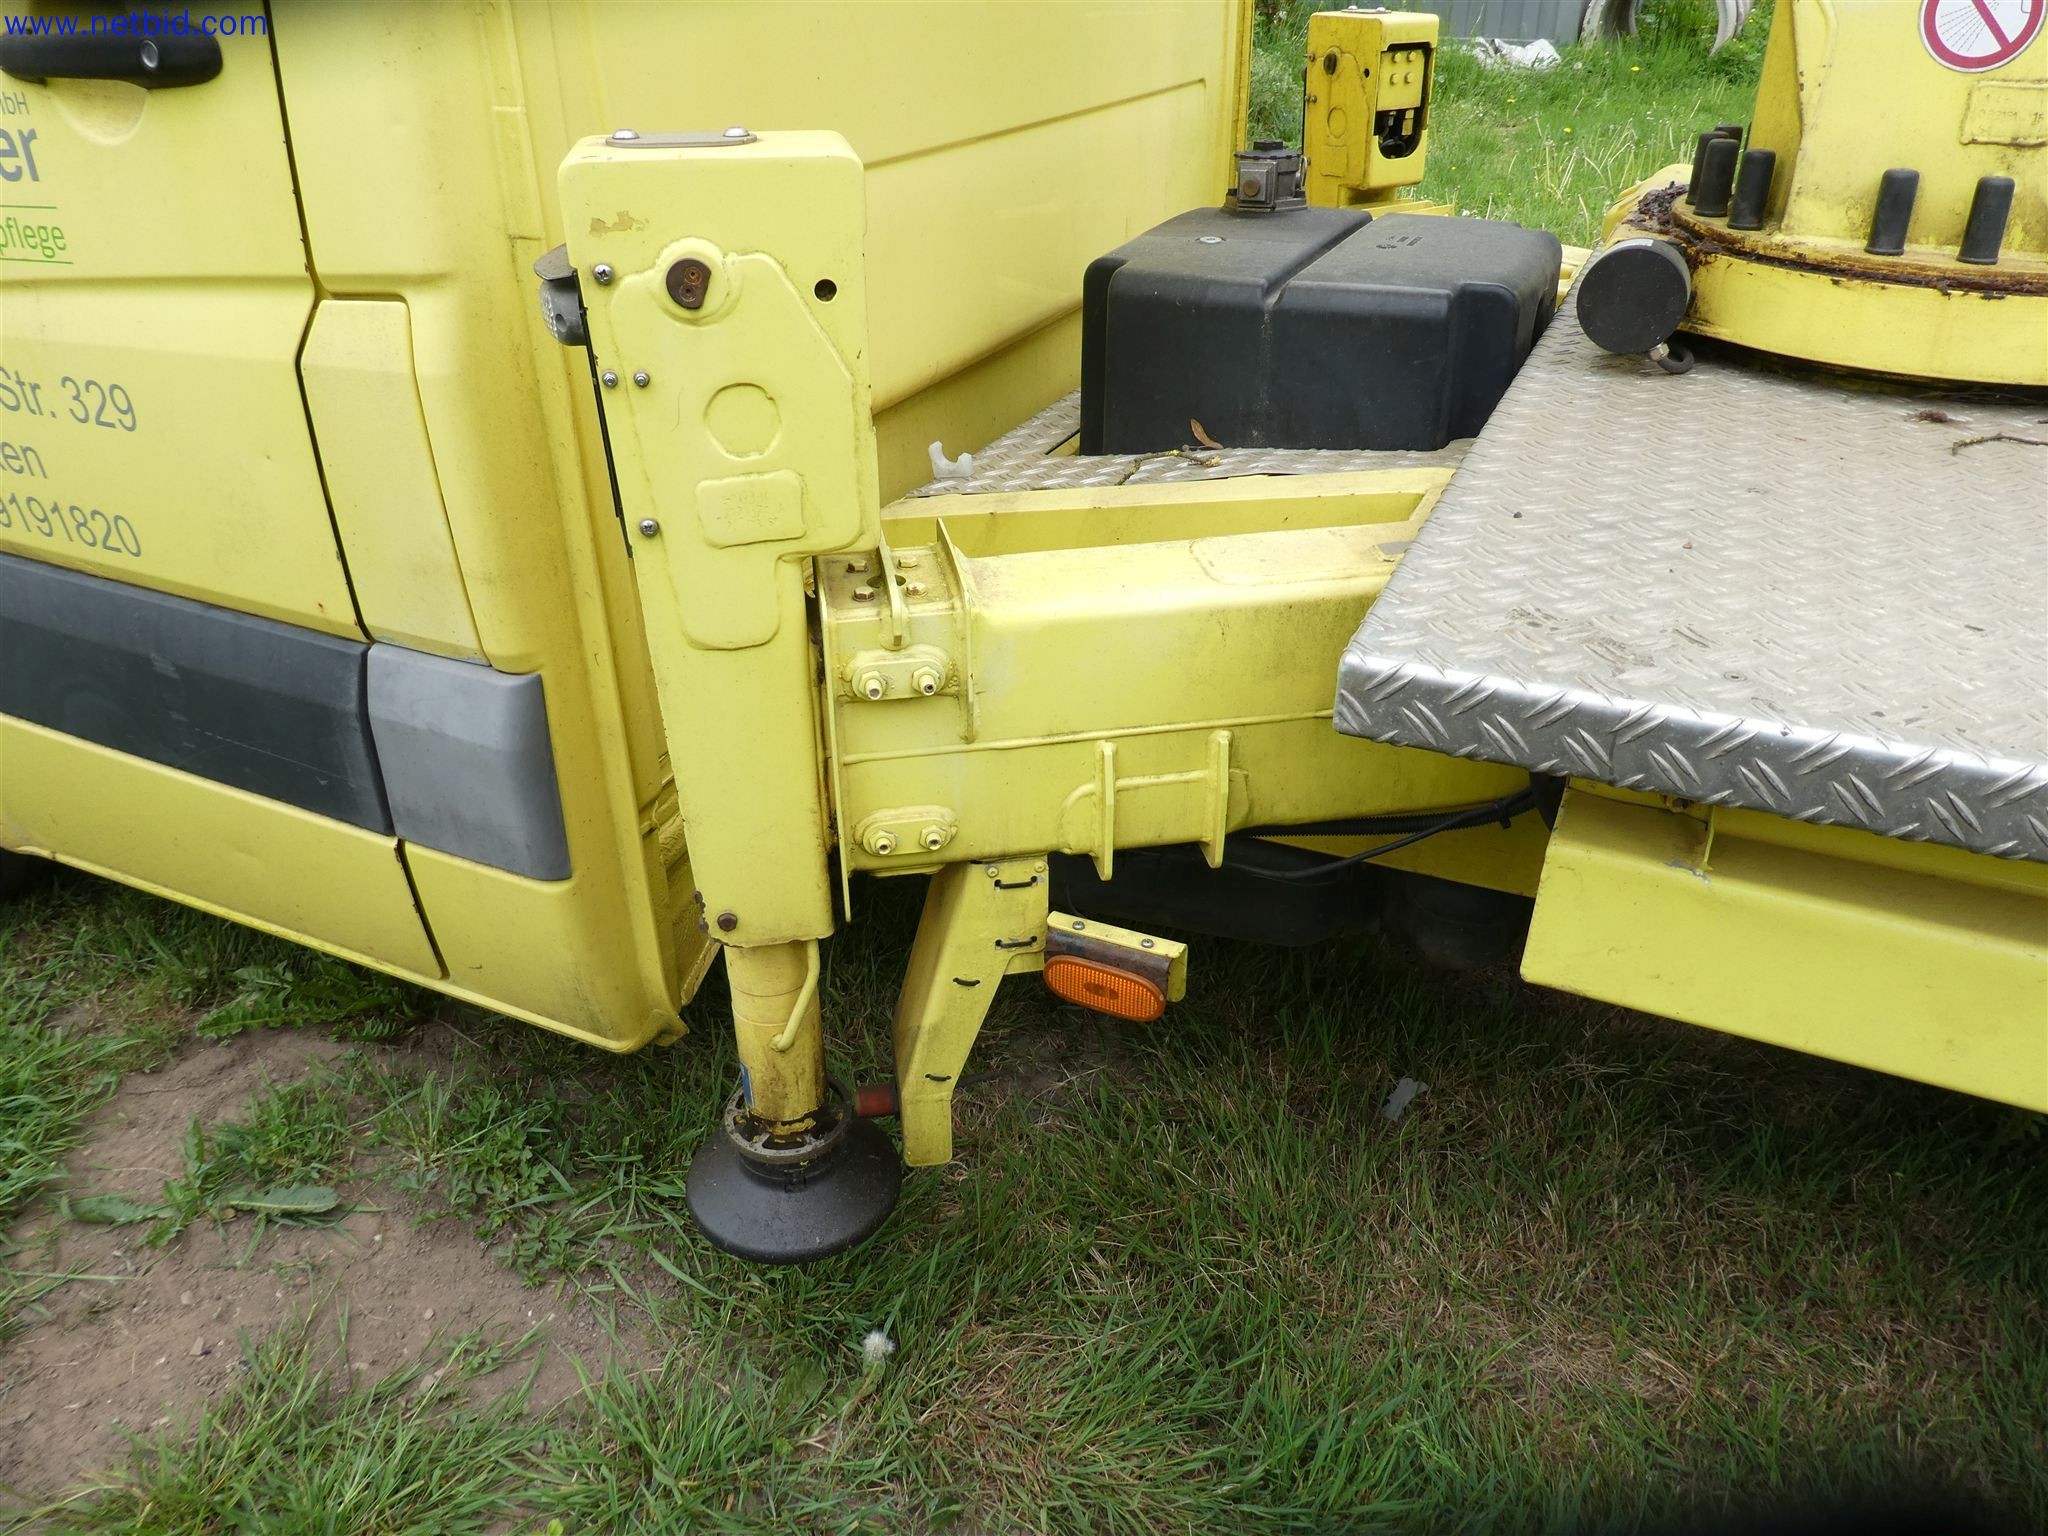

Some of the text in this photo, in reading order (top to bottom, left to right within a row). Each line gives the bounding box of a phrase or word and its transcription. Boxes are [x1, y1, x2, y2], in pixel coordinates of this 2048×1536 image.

[0, 91, 30, 115] bH
[0, 127, 40, 182] er
[0, 366, 137, 432] Str. 329
[0, 441, 47, 479] en
